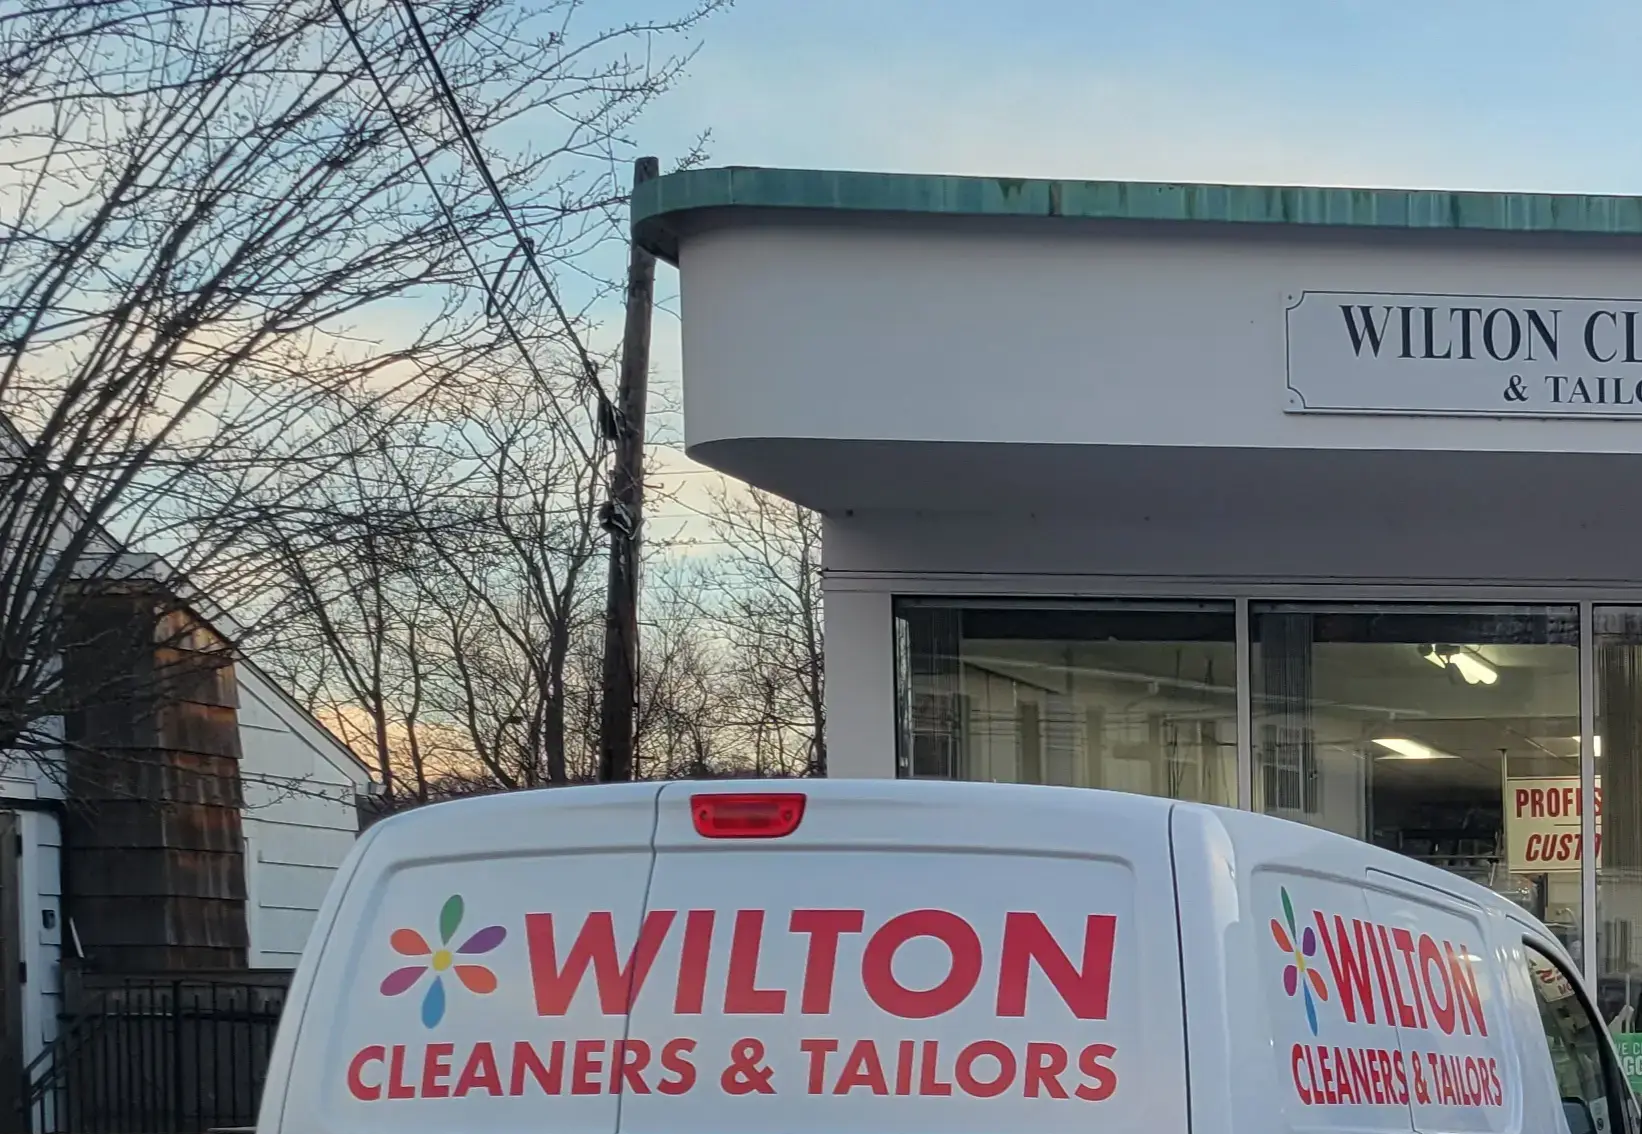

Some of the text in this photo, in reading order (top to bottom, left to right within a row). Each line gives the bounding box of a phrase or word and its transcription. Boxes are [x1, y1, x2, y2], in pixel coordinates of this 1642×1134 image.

[1338, 304, 1563, 362] WILTON
[1503, 375, 1528, 403] &
[525, 908, 1117, 1020] WILTON
[1313, 910, 1488, 1037] WILTON
[347, 1037, 1117, 1103] CLEANERS & TAILORS
[1292, 1043, 1503, 1107] CLEANERS & TAILORS
